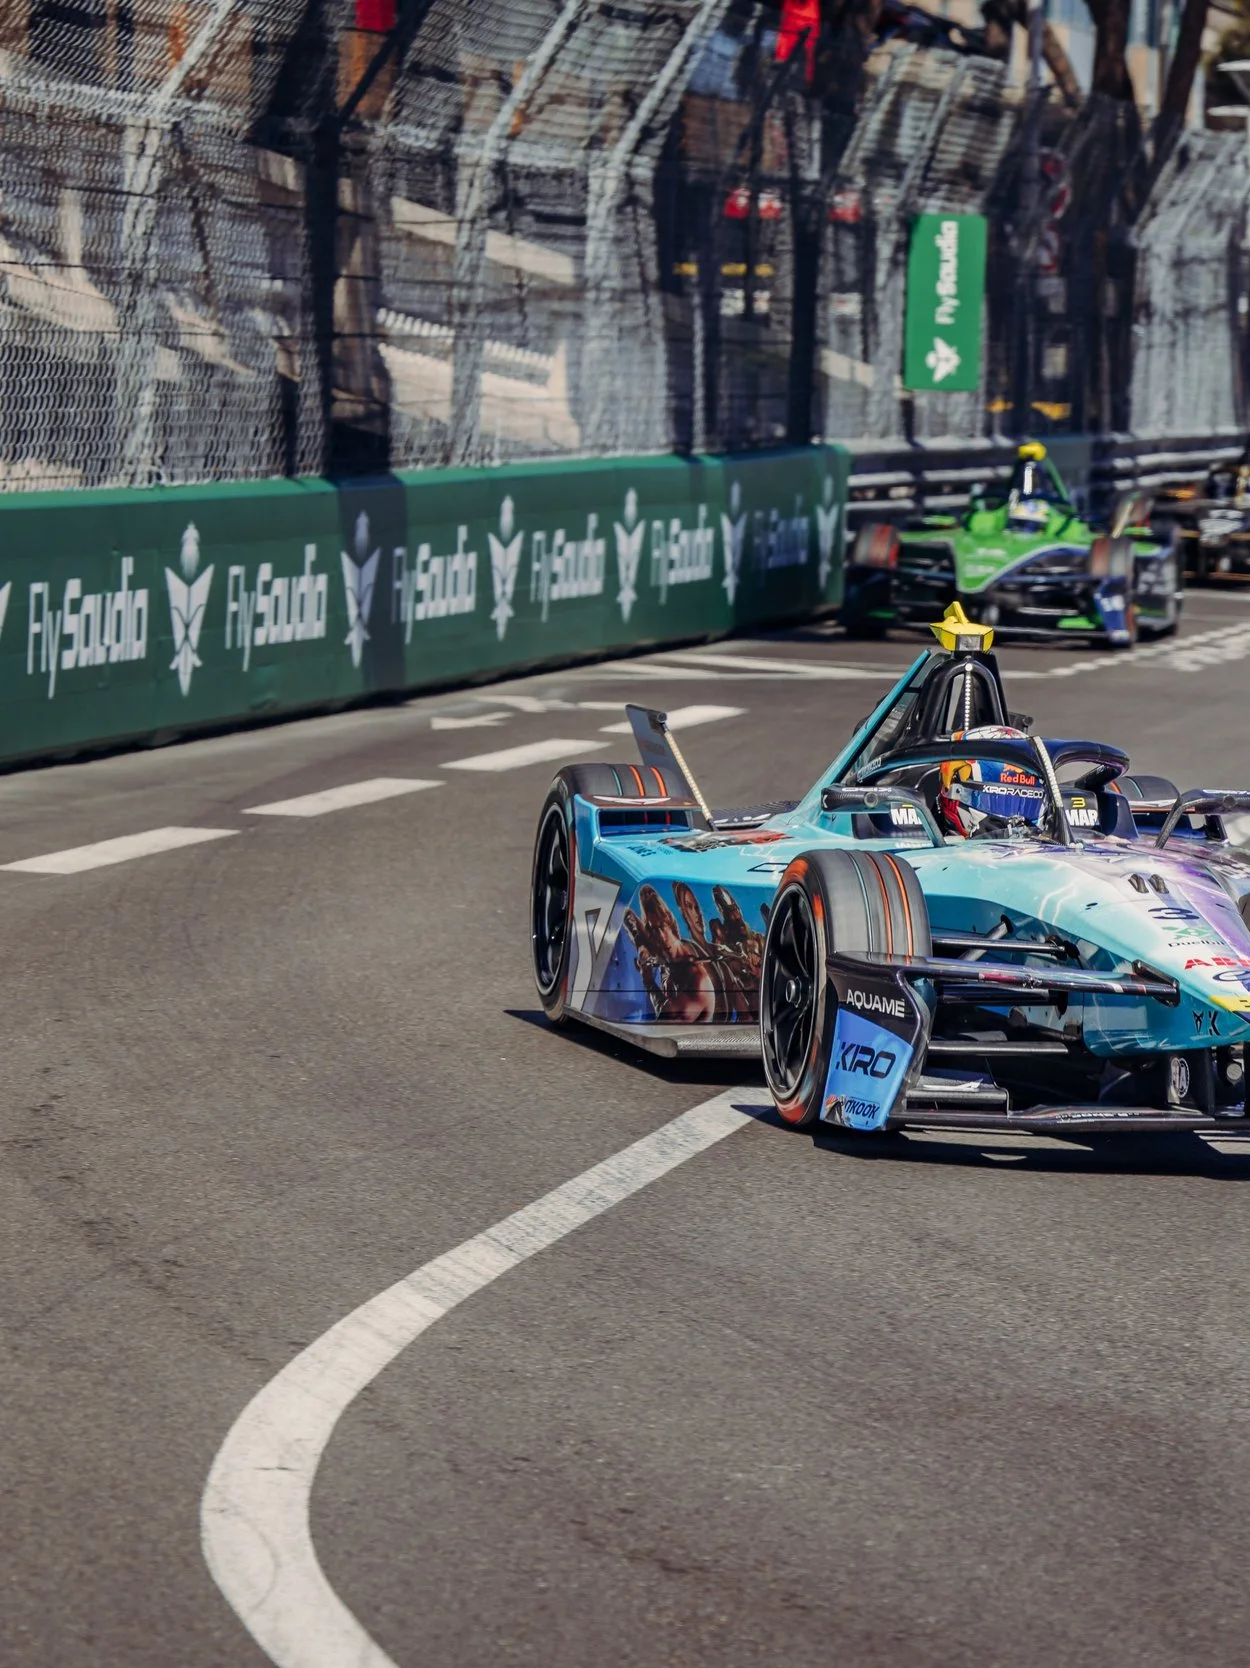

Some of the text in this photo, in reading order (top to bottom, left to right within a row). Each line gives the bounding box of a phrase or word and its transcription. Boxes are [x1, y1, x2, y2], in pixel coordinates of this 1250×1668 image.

[935, 220, 961, 325] FlySaudia
[390, 524, 479, 645] FlySaudia
[530, 512, 607, 623] FlySaudia
[224, 543, 329, 673] FlySaudia
[27, 555, 149, 700] FlySaudia
[1000, 773, 1035, 786] Red Bull
[890, 808, 923, 825] MA
[1071, 796, 1086, 808] 3
[1148, 907, 1200, 920] 3
[835, 1042, 897, 1079] KIRO
[845, 1099, 881, 1119] NKOOK
